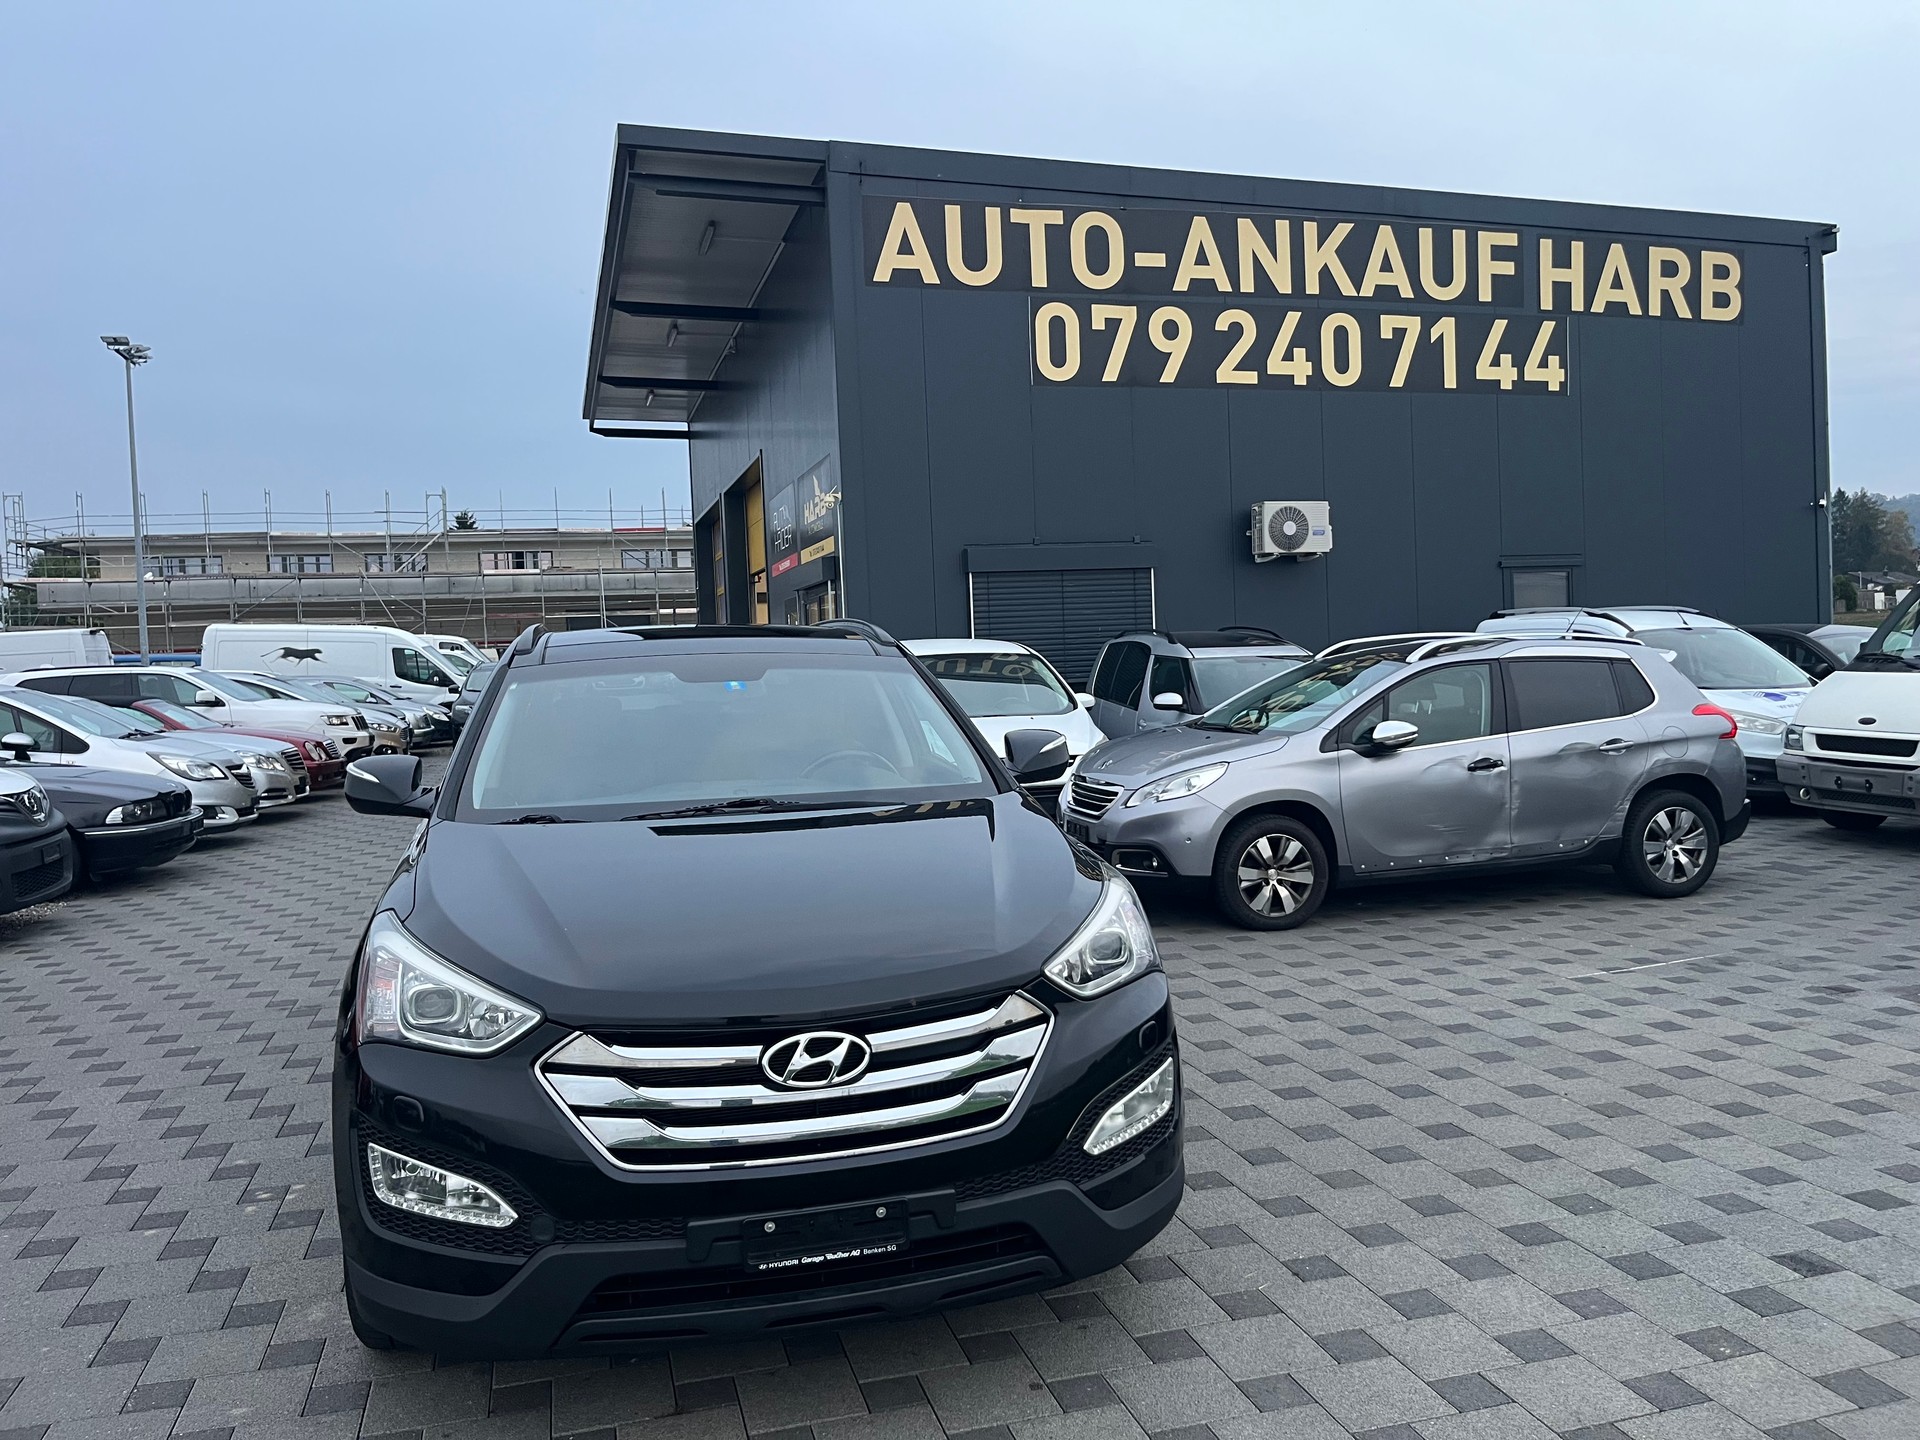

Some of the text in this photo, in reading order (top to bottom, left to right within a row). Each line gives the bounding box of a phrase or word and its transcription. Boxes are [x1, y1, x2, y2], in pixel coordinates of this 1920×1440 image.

[873, 201, 1742, 321] AUTO-ANKAUF HARB
[1035, 301, 1566, 392] 079 240 71 44
[804, 493, 827, 525] HARB
[768, 1259, 799, 1269] HYUNDAI
[801, 1256, 825, 1264] Garage
[850, 1249, 862, 1257] AG
[863, 1246, 886, 1255] Benken
[887, 1244, 897, 1252] SG
